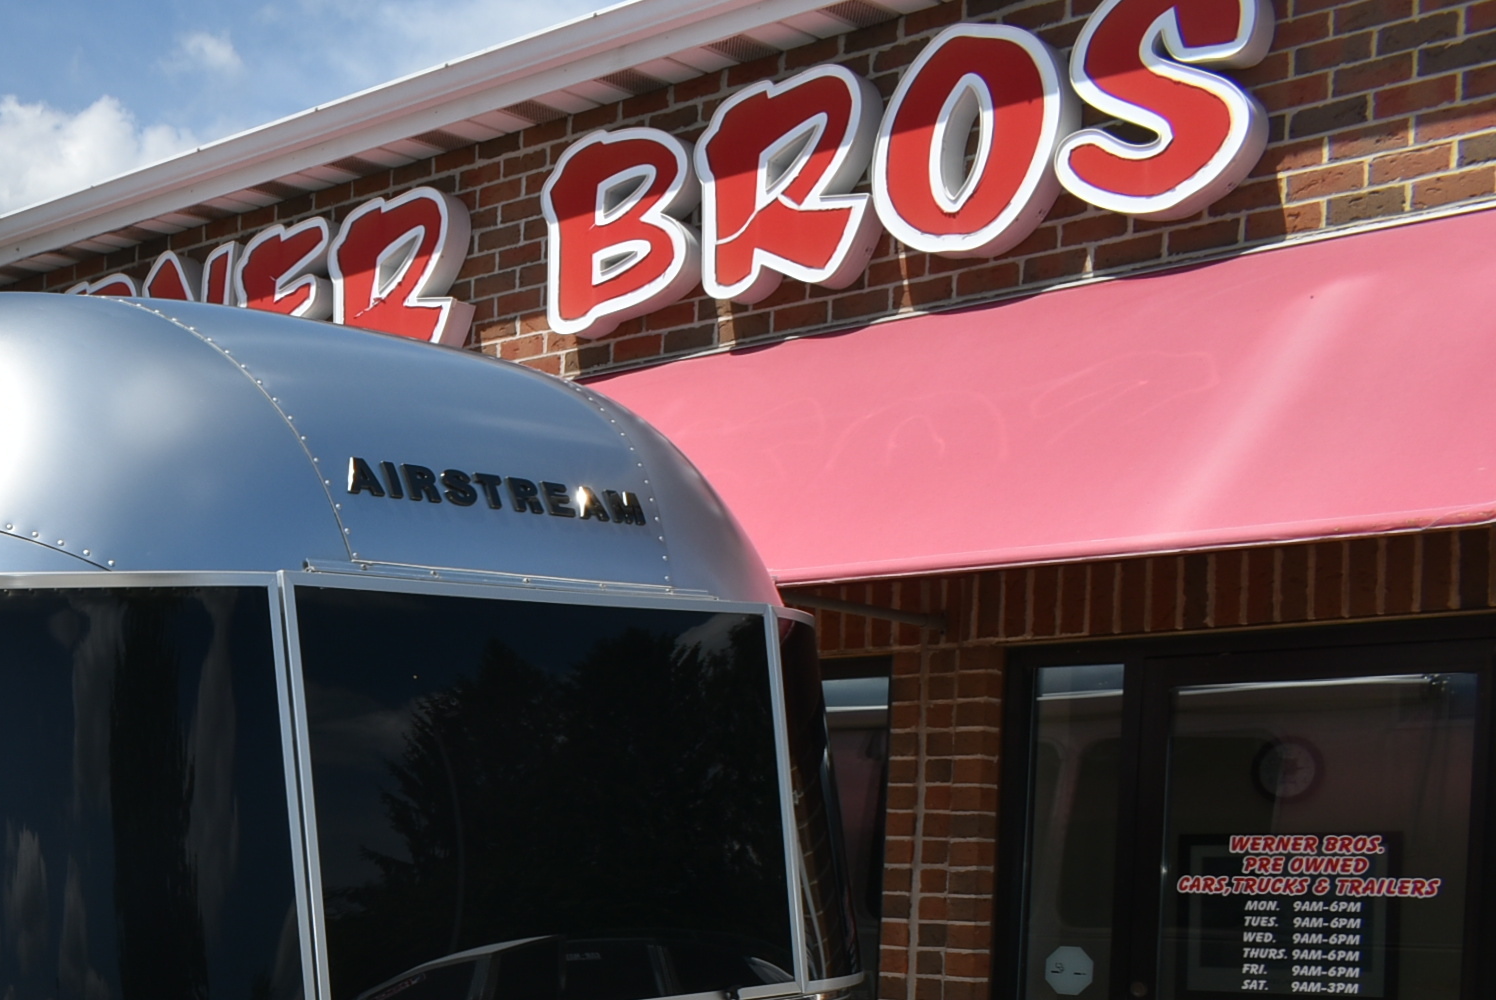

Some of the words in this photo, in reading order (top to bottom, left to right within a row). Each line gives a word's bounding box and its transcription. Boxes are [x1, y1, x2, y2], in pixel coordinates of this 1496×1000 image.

[540, 0, 1268, 336] BROS
[347, 457, 646, 526] AIRSTREAM
[1229, 835, 1318, 854] WERNER
[1322, 835, 1384, 855] BROS.
[1242, 856, 1285, 875] PRE
[1288, 856, 1369, 875] OWNED
[1313, 877, 1330, 895] &
[1336, 878, 1441, 898] TRAILERS
[1244, 900, 1280, 911] MON.
[1293, 900, 1362, 913] 9AM-6PM
[1244, 916, 1278, 927] TUES.
[1293, 916, 1362, 929] 9AM-6PM
[1243, 931, 1276, 943] WED.
[1292, 932, 1361, 945] 9AM-6PM
[1243, 947, 1288, 960] THURS.
[1291, 949, 1360, 962] 9AM-6PM
[1242, 963, 1267, 975] FRI.
[1291, 965, 1360, 978] 9AM-6PM
[1241, 979, 1269, 991] SAT.
[1291, 981, 1359, 994] 9AM-3PM
